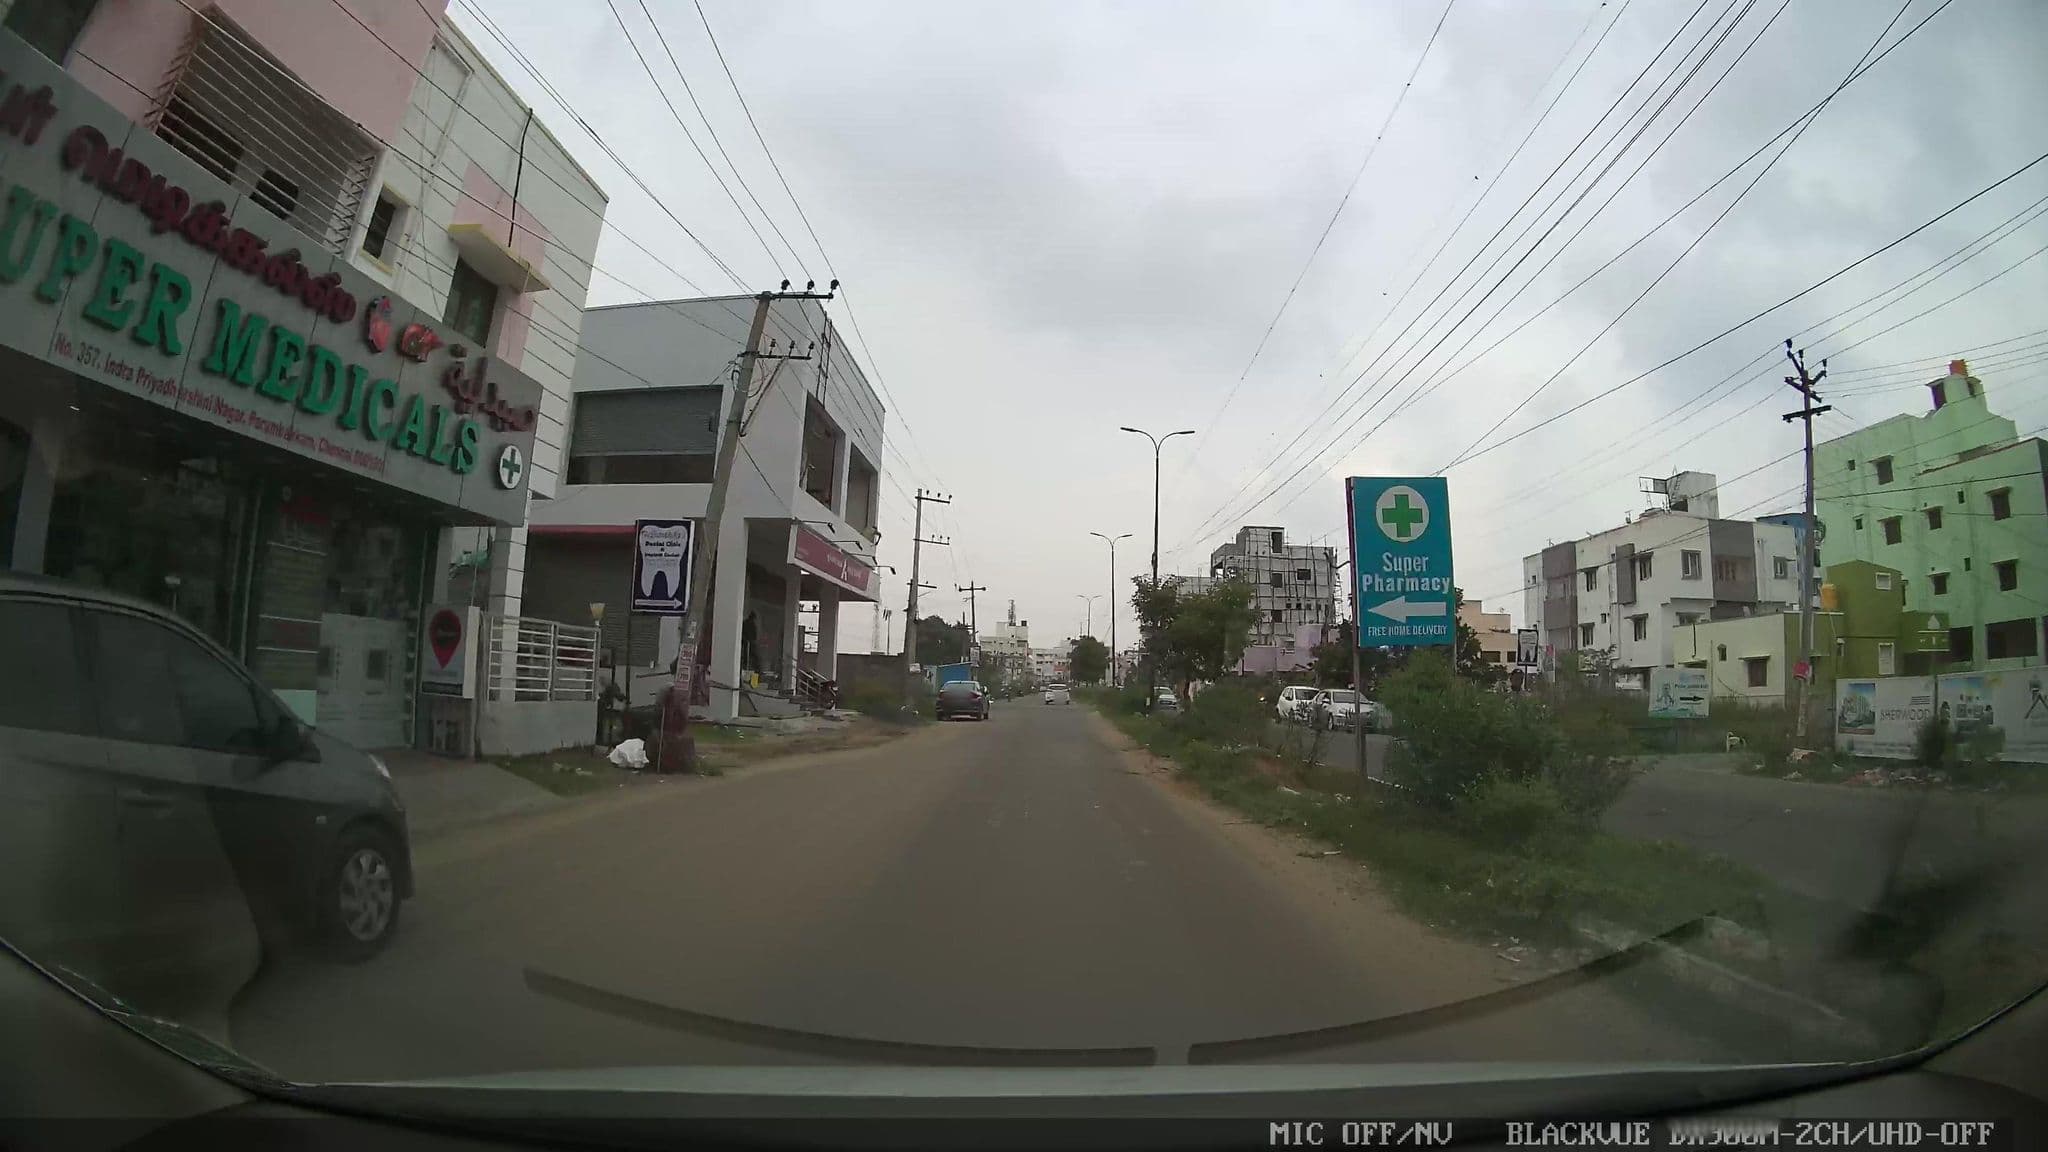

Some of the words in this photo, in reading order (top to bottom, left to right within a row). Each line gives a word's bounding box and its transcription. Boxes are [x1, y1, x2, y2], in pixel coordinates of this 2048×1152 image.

[0, 184, 192, 356] UPER
[202, 298, 481, 475] MEDICALS
[1382, 551, 1429, 576] Super
[1362, 573, 1450, 594] Pharmacy
[1368, 627, 1387, 637] FREE
[1389, 625, 1411, 636] HOME
[1412, 623, 1447, 636] DELIVERY
